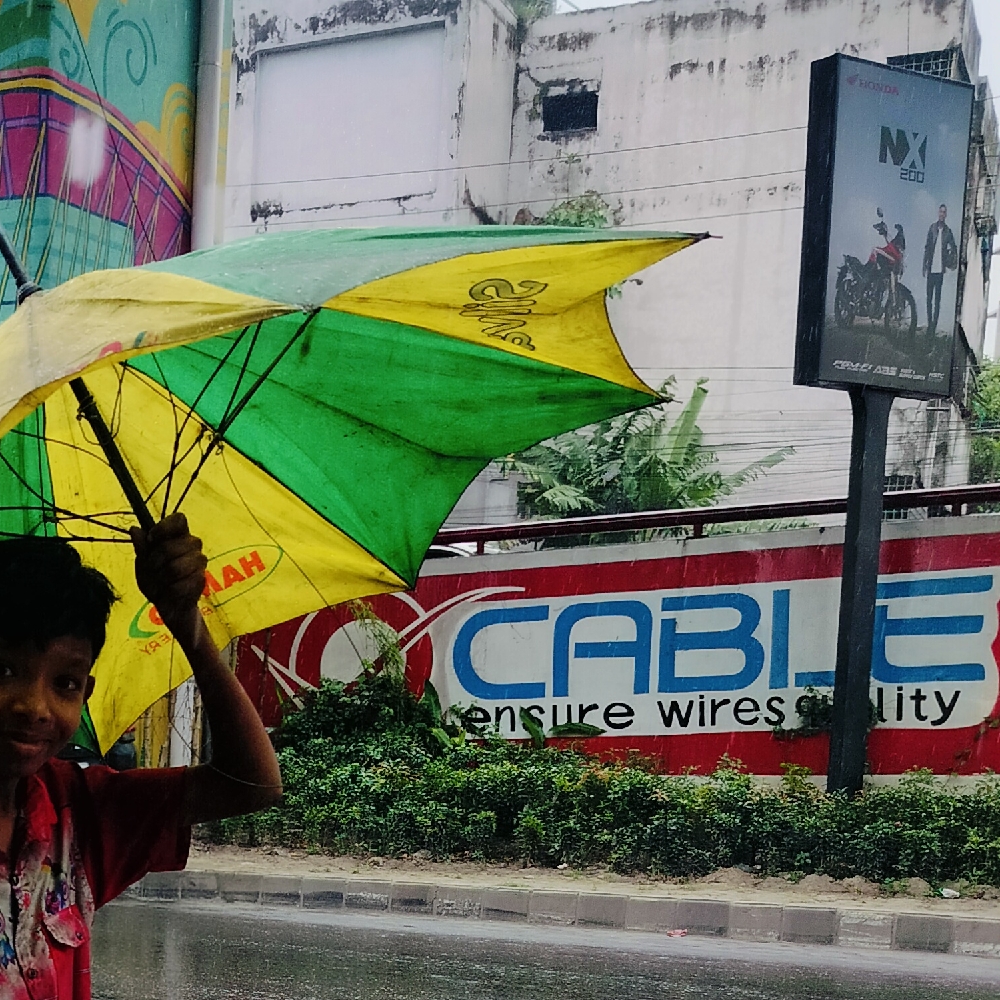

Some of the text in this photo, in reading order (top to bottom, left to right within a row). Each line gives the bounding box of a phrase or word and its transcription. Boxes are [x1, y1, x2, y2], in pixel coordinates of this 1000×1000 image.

[859, 78, 899, 95] HONDA
[879, 125, 928, 169] NX
[900, 167, 925, 184] 200
[452, 575, 994, 700] CABLE
[460, 701, 635, 738] ensure
[656, 693, 786, 729] wires
